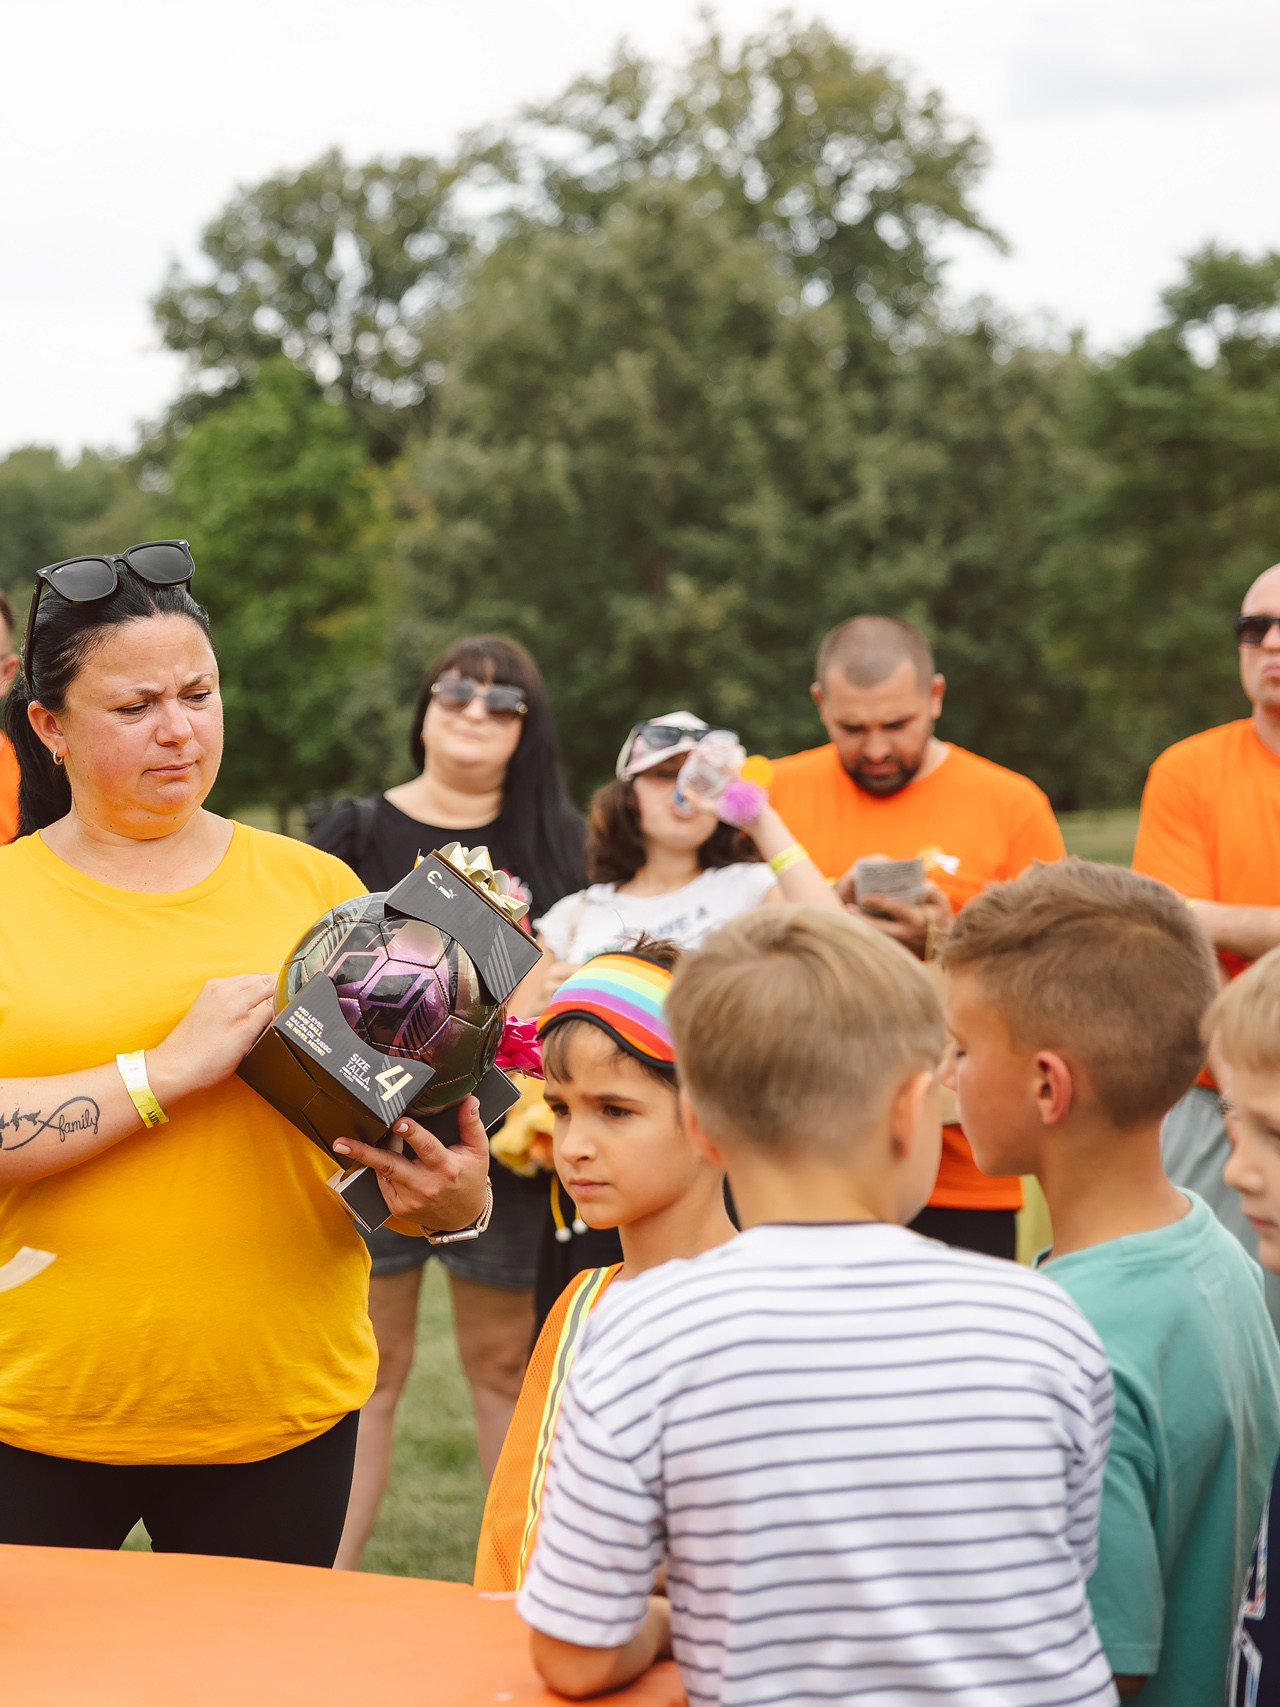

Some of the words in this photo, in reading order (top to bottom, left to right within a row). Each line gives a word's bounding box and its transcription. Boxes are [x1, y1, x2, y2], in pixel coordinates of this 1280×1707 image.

[293, 1010, 310, 1027] GAME
[309, 1022, 323, 1037] BALL
[297, 1005, 309, 1017] MID
[308, 1013, 324, 1031] LEVEL
[285, 1020, 293, 1030] DE
[292, 1025, 308, 1043] NIVEL
[307, 1039, 326, 1057] MEDIO
[289, 1015, 308, 1033] BALÓN
[306, 1028, 316, 1040] DE
[314, 1036, 332, 1054] JUEGO
[345, 1059, 371, 1086] TALLA
[350, 1053, 372, 1073] SIZE
[374, 1064, 414, 1102] 4
[59, 1109, 98, 1143] family
